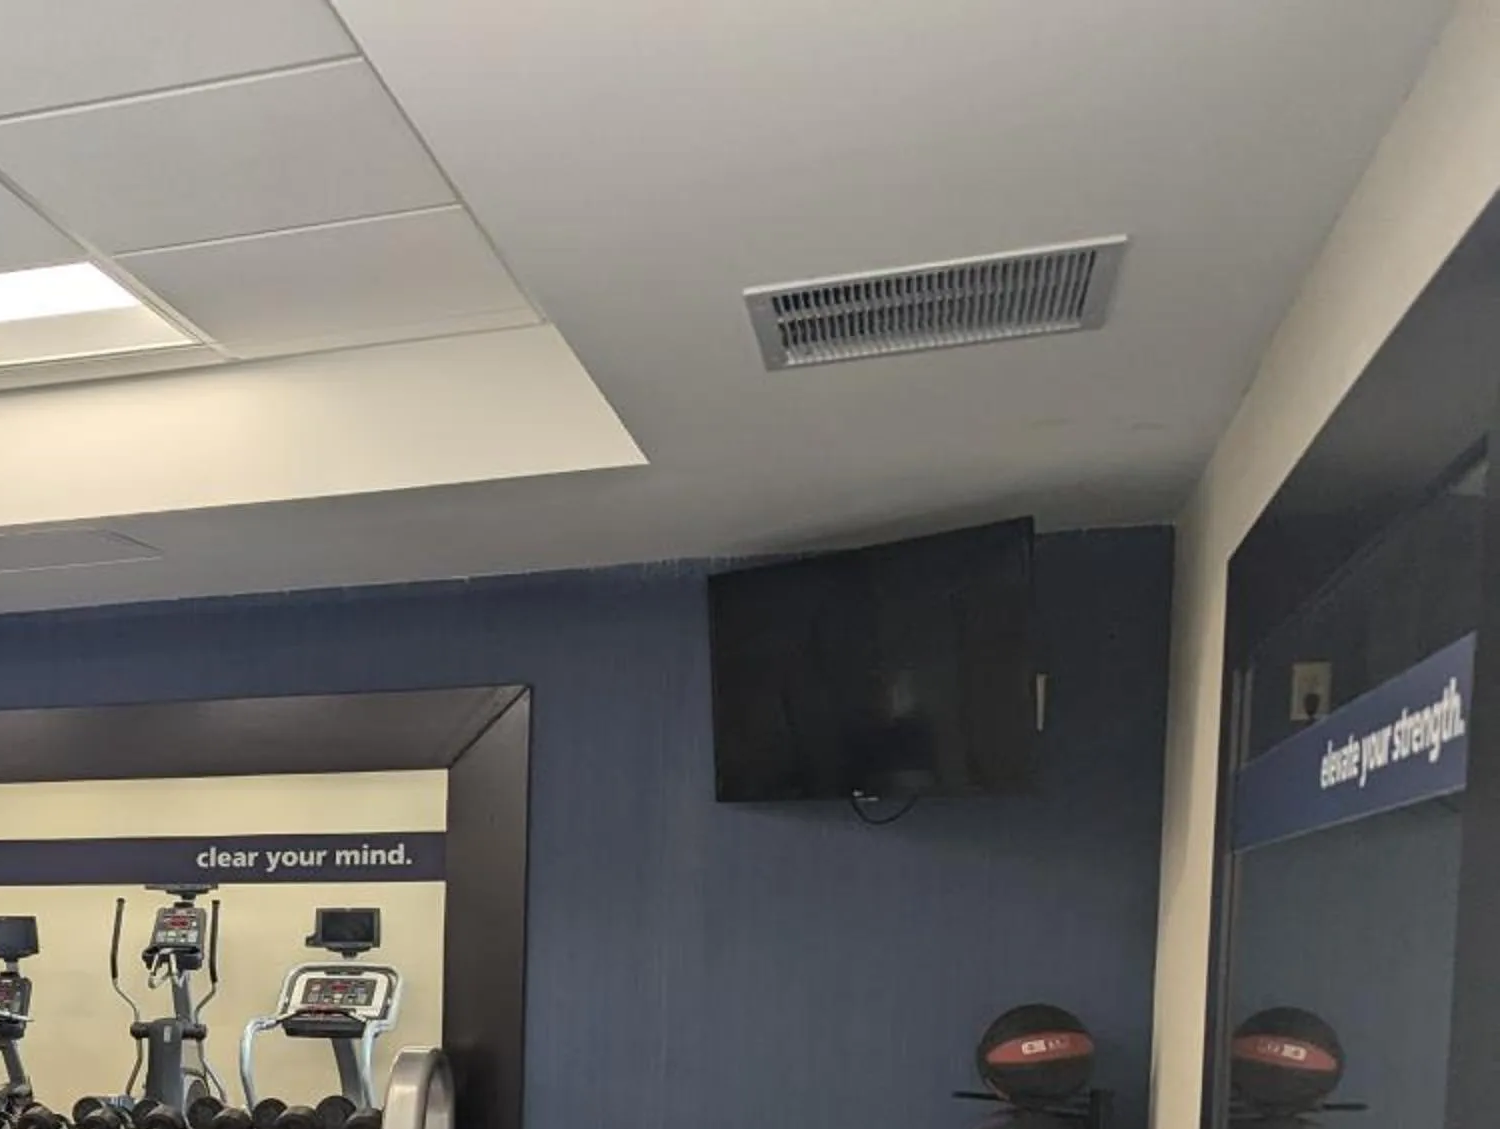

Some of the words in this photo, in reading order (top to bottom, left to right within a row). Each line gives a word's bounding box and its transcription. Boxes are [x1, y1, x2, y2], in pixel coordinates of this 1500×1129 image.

[1359, 724, 1393, 788] your
[197, 847, 259, 868] clear
[266, 848, 328, 872] your
[335, 843, 412, 866] mind.
